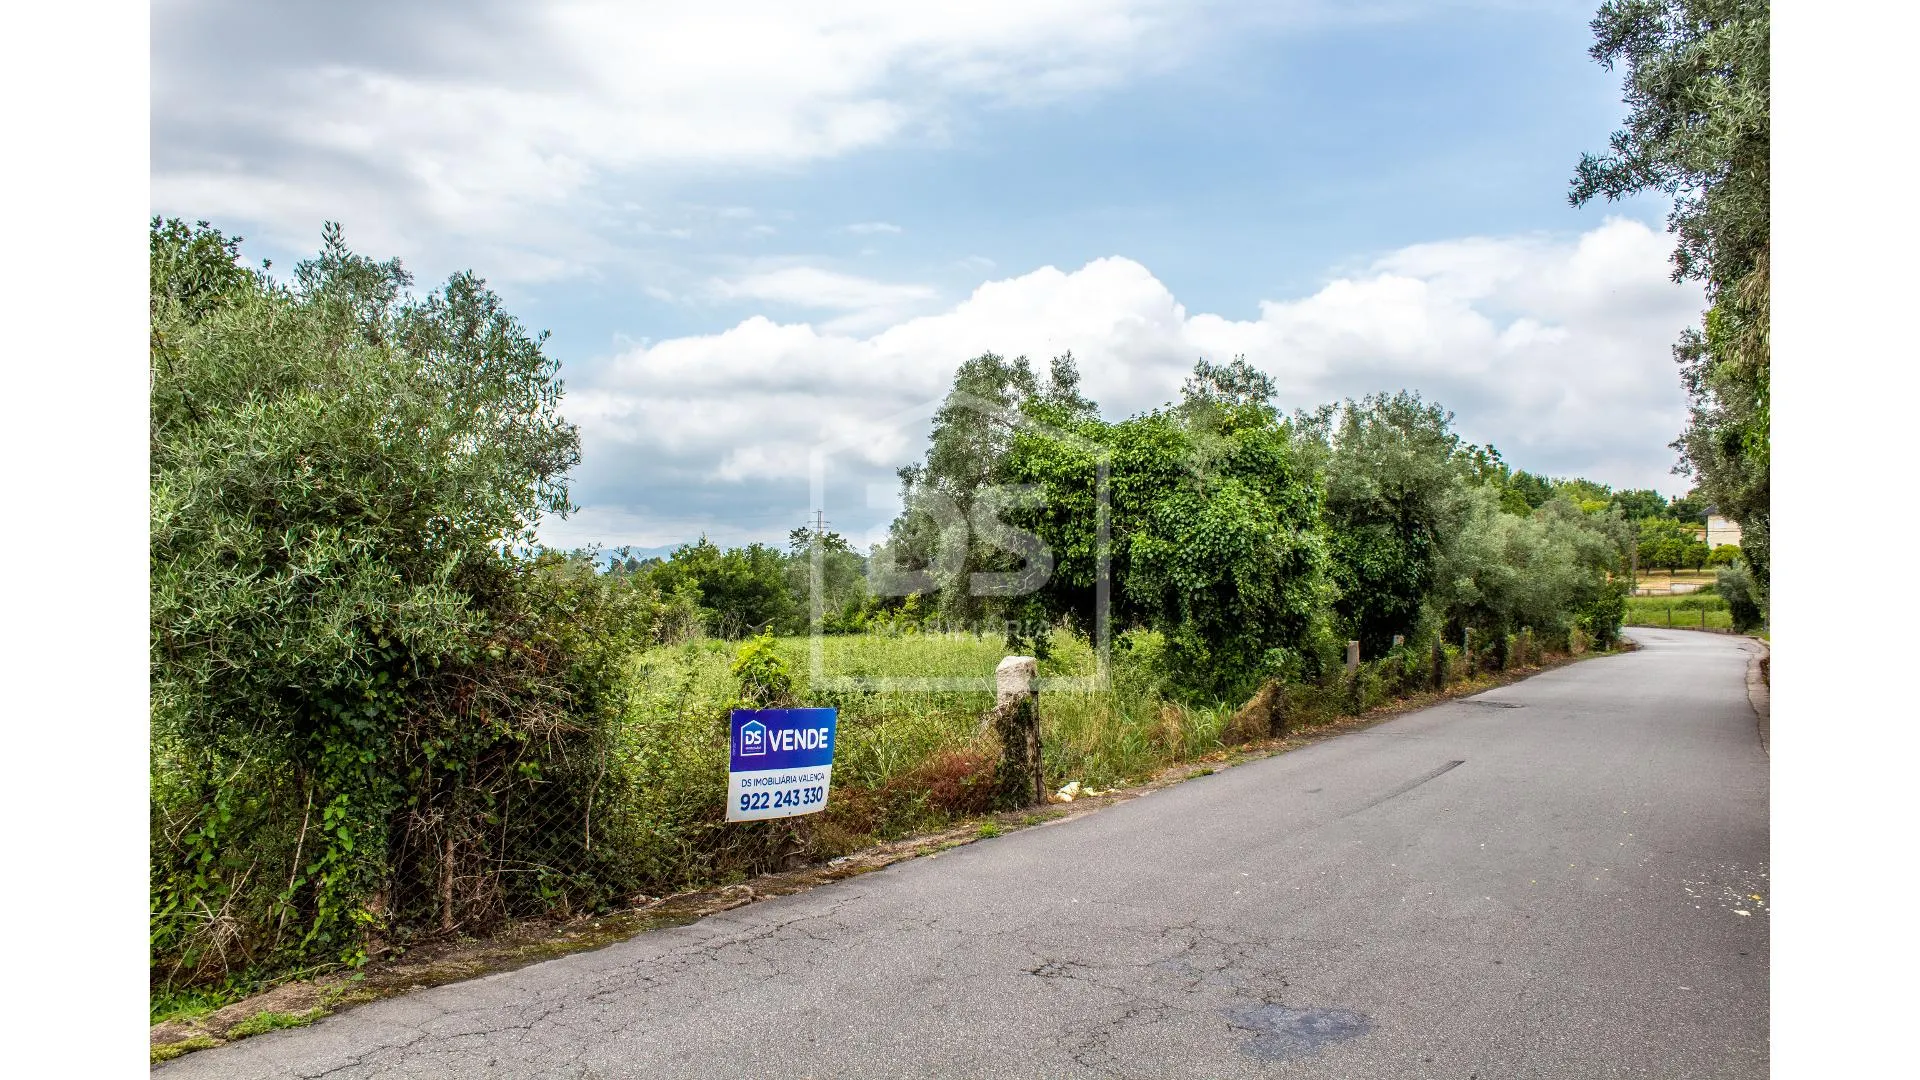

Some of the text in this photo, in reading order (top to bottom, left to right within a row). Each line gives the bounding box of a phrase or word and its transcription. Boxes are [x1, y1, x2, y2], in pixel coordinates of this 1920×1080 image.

[745, 730, 762, 745] DS
[768, 727, 829, 752] VENDE
[741, 772, 825, 788] DS IMOBILIÁRIA VALENÇA
[740, 786, 824, 811] 922 243 330
